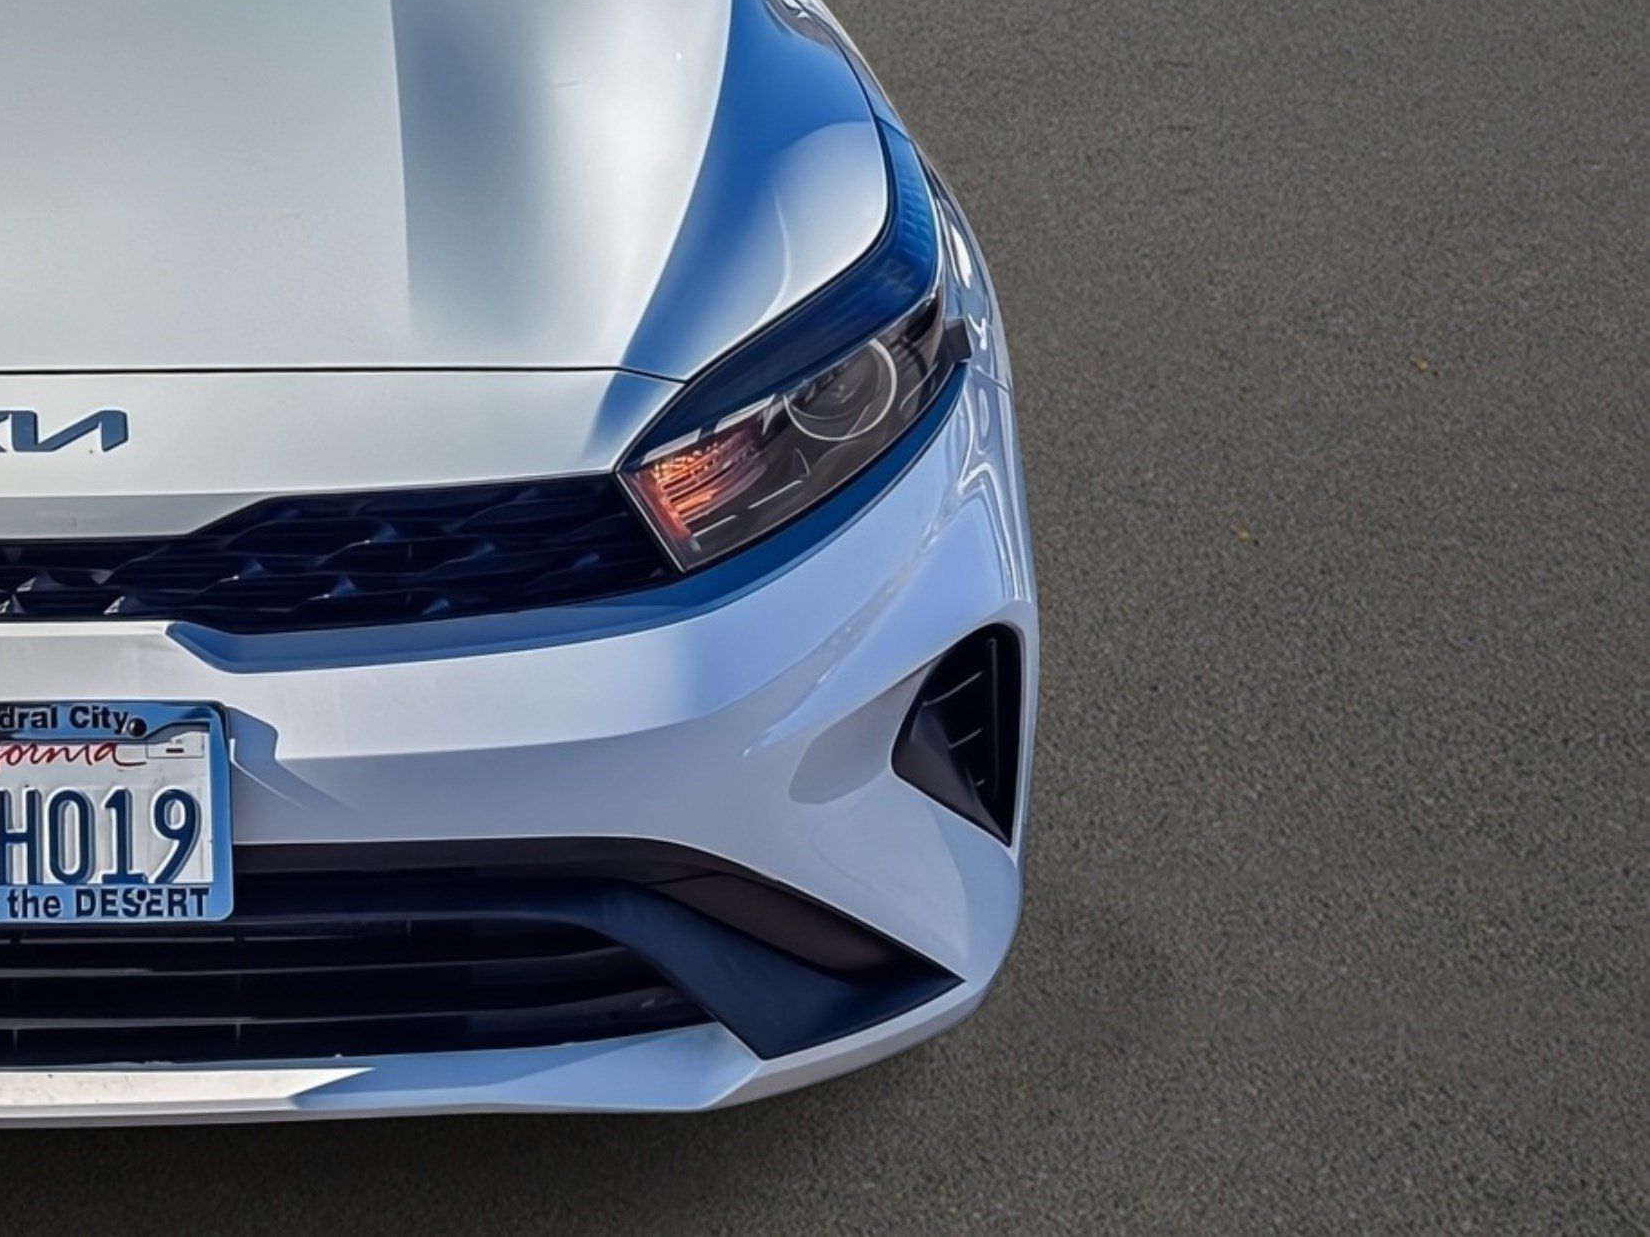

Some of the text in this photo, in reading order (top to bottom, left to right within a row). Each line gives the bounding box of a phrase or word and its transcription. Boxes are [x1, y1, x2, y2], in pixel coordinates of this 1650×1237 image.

[68, 706, 129, 734] City
[7, 888, 61, 918] the
[75, 888, 210, 918] DESERT
